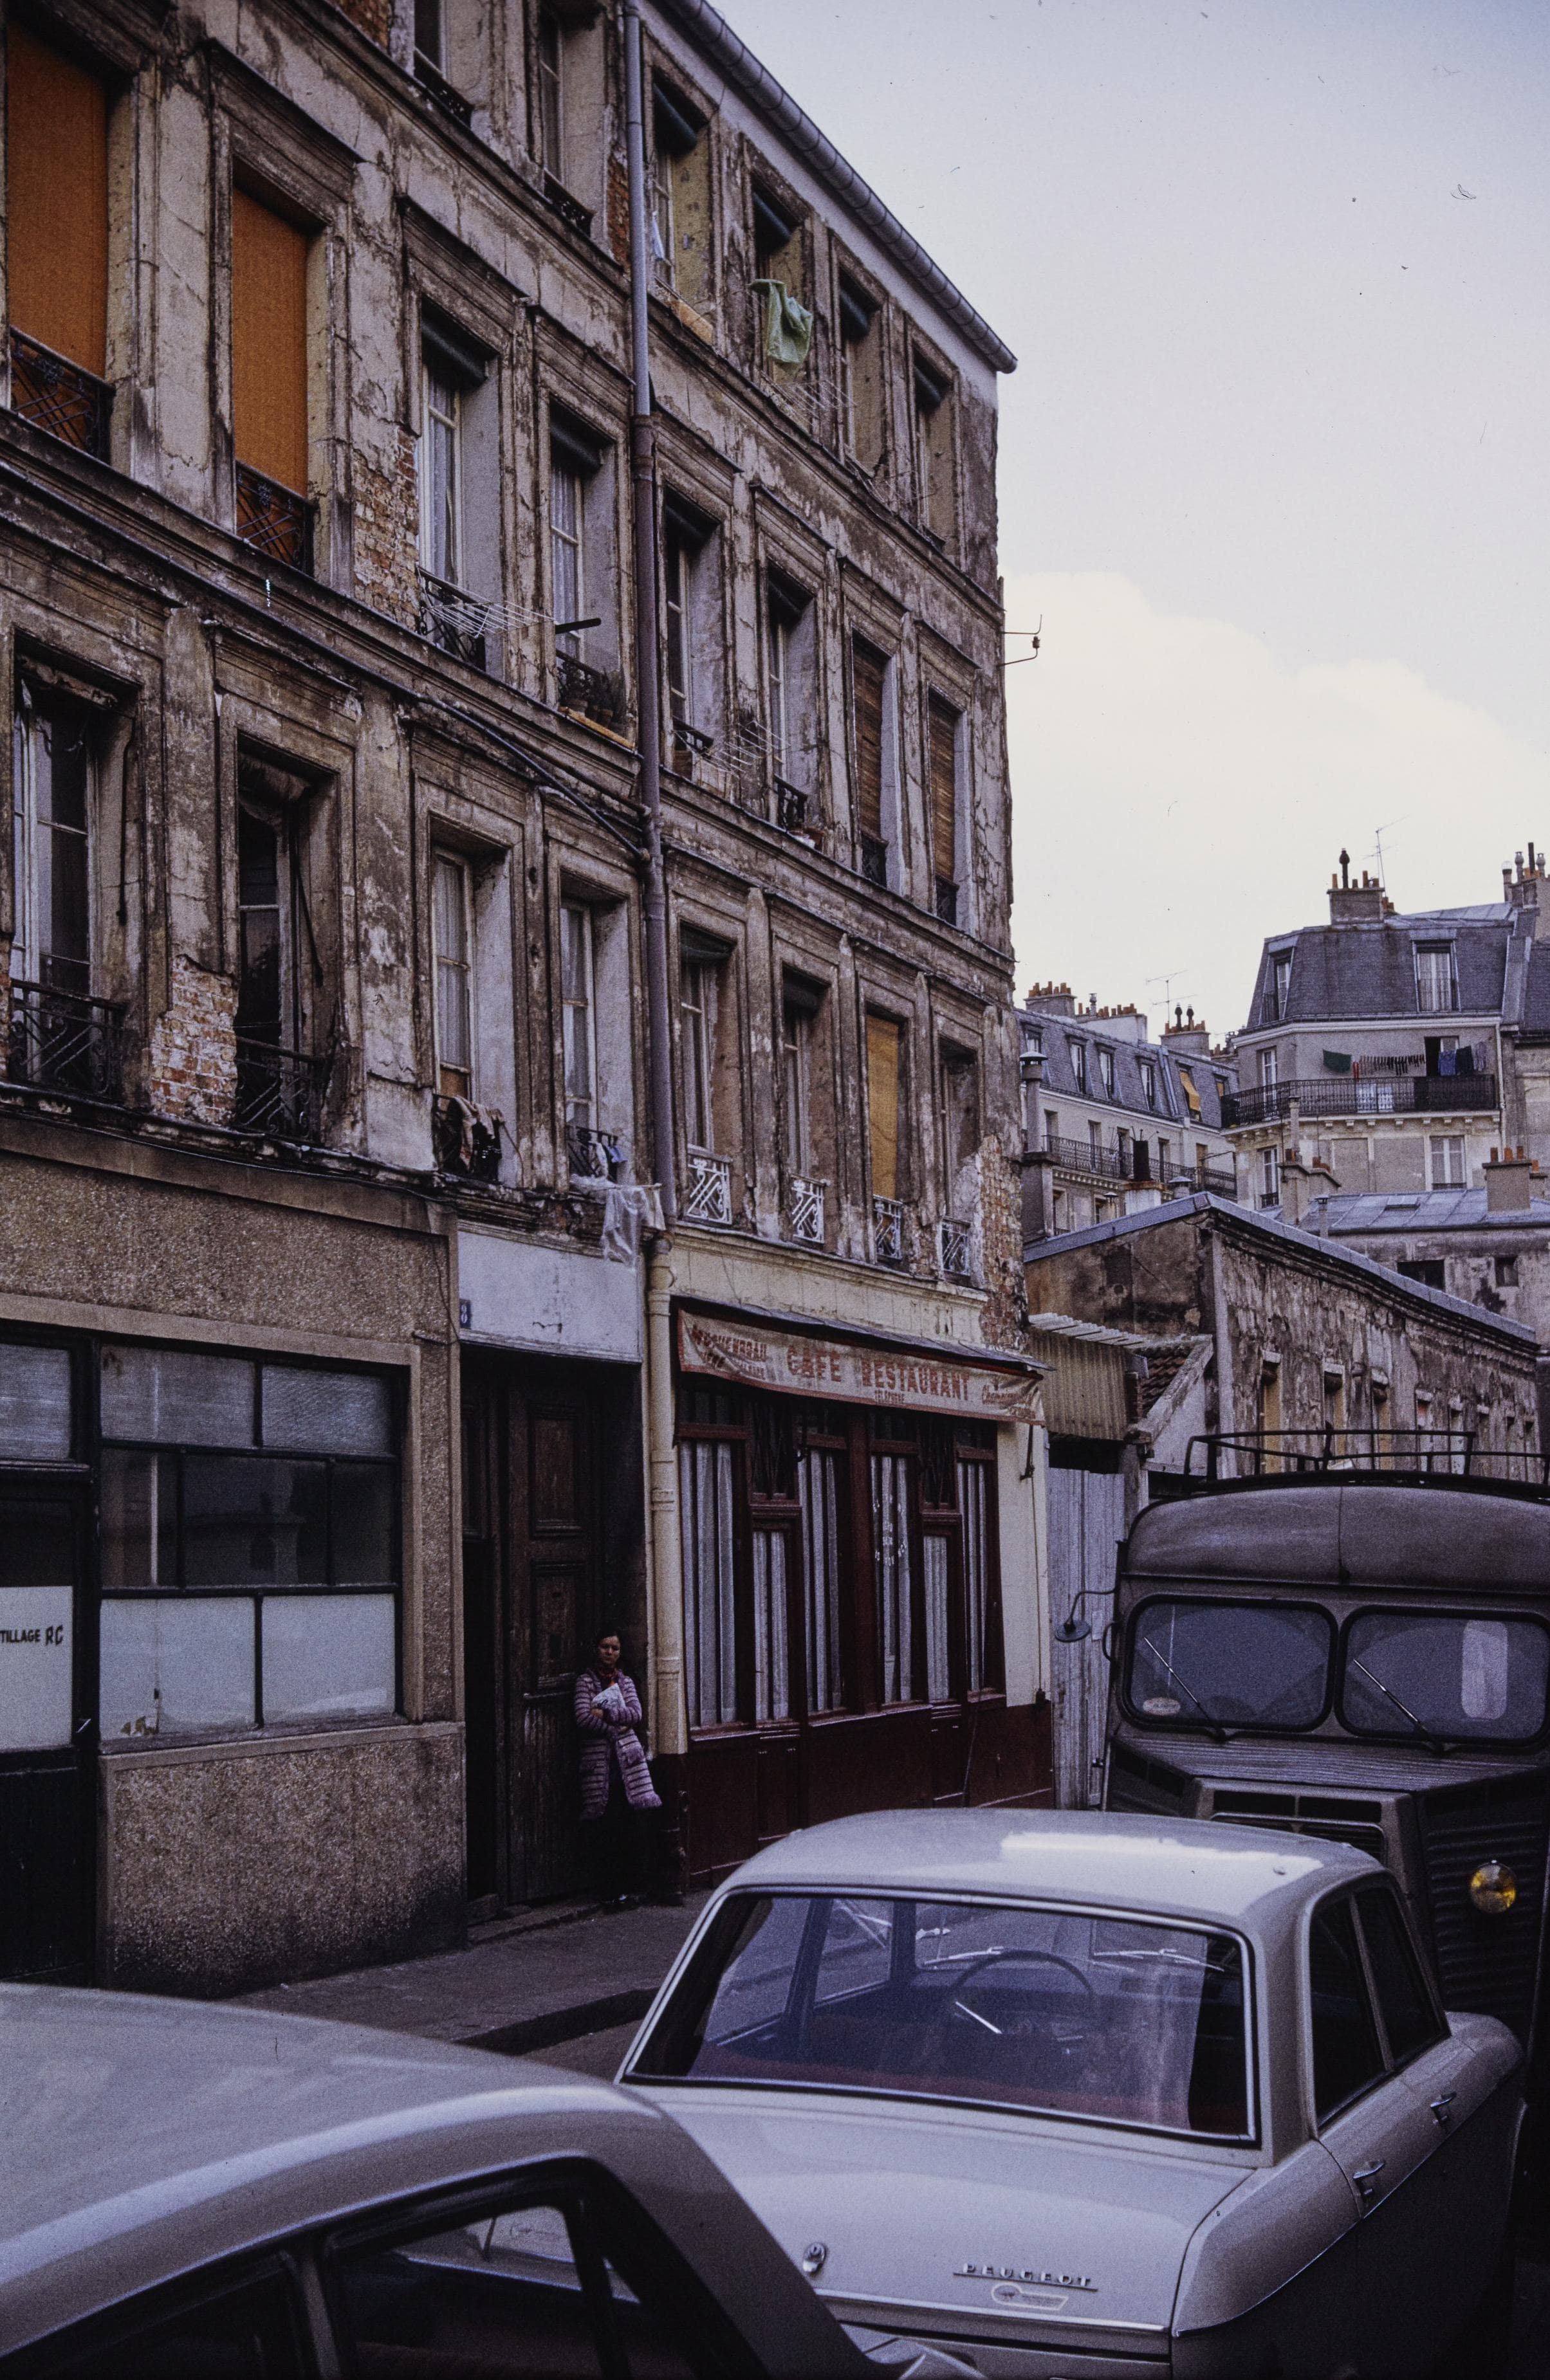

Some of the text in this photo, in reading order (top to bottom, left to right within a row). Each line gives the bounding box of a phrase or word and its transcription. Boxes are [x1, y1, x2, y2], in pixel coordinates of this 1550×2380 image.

[787, 1344, 842, 1383] CAFE
[860, 1358, 970, 1401] RESTAURANT
[963, 2262, 1091, 2287] PEUGEOT
